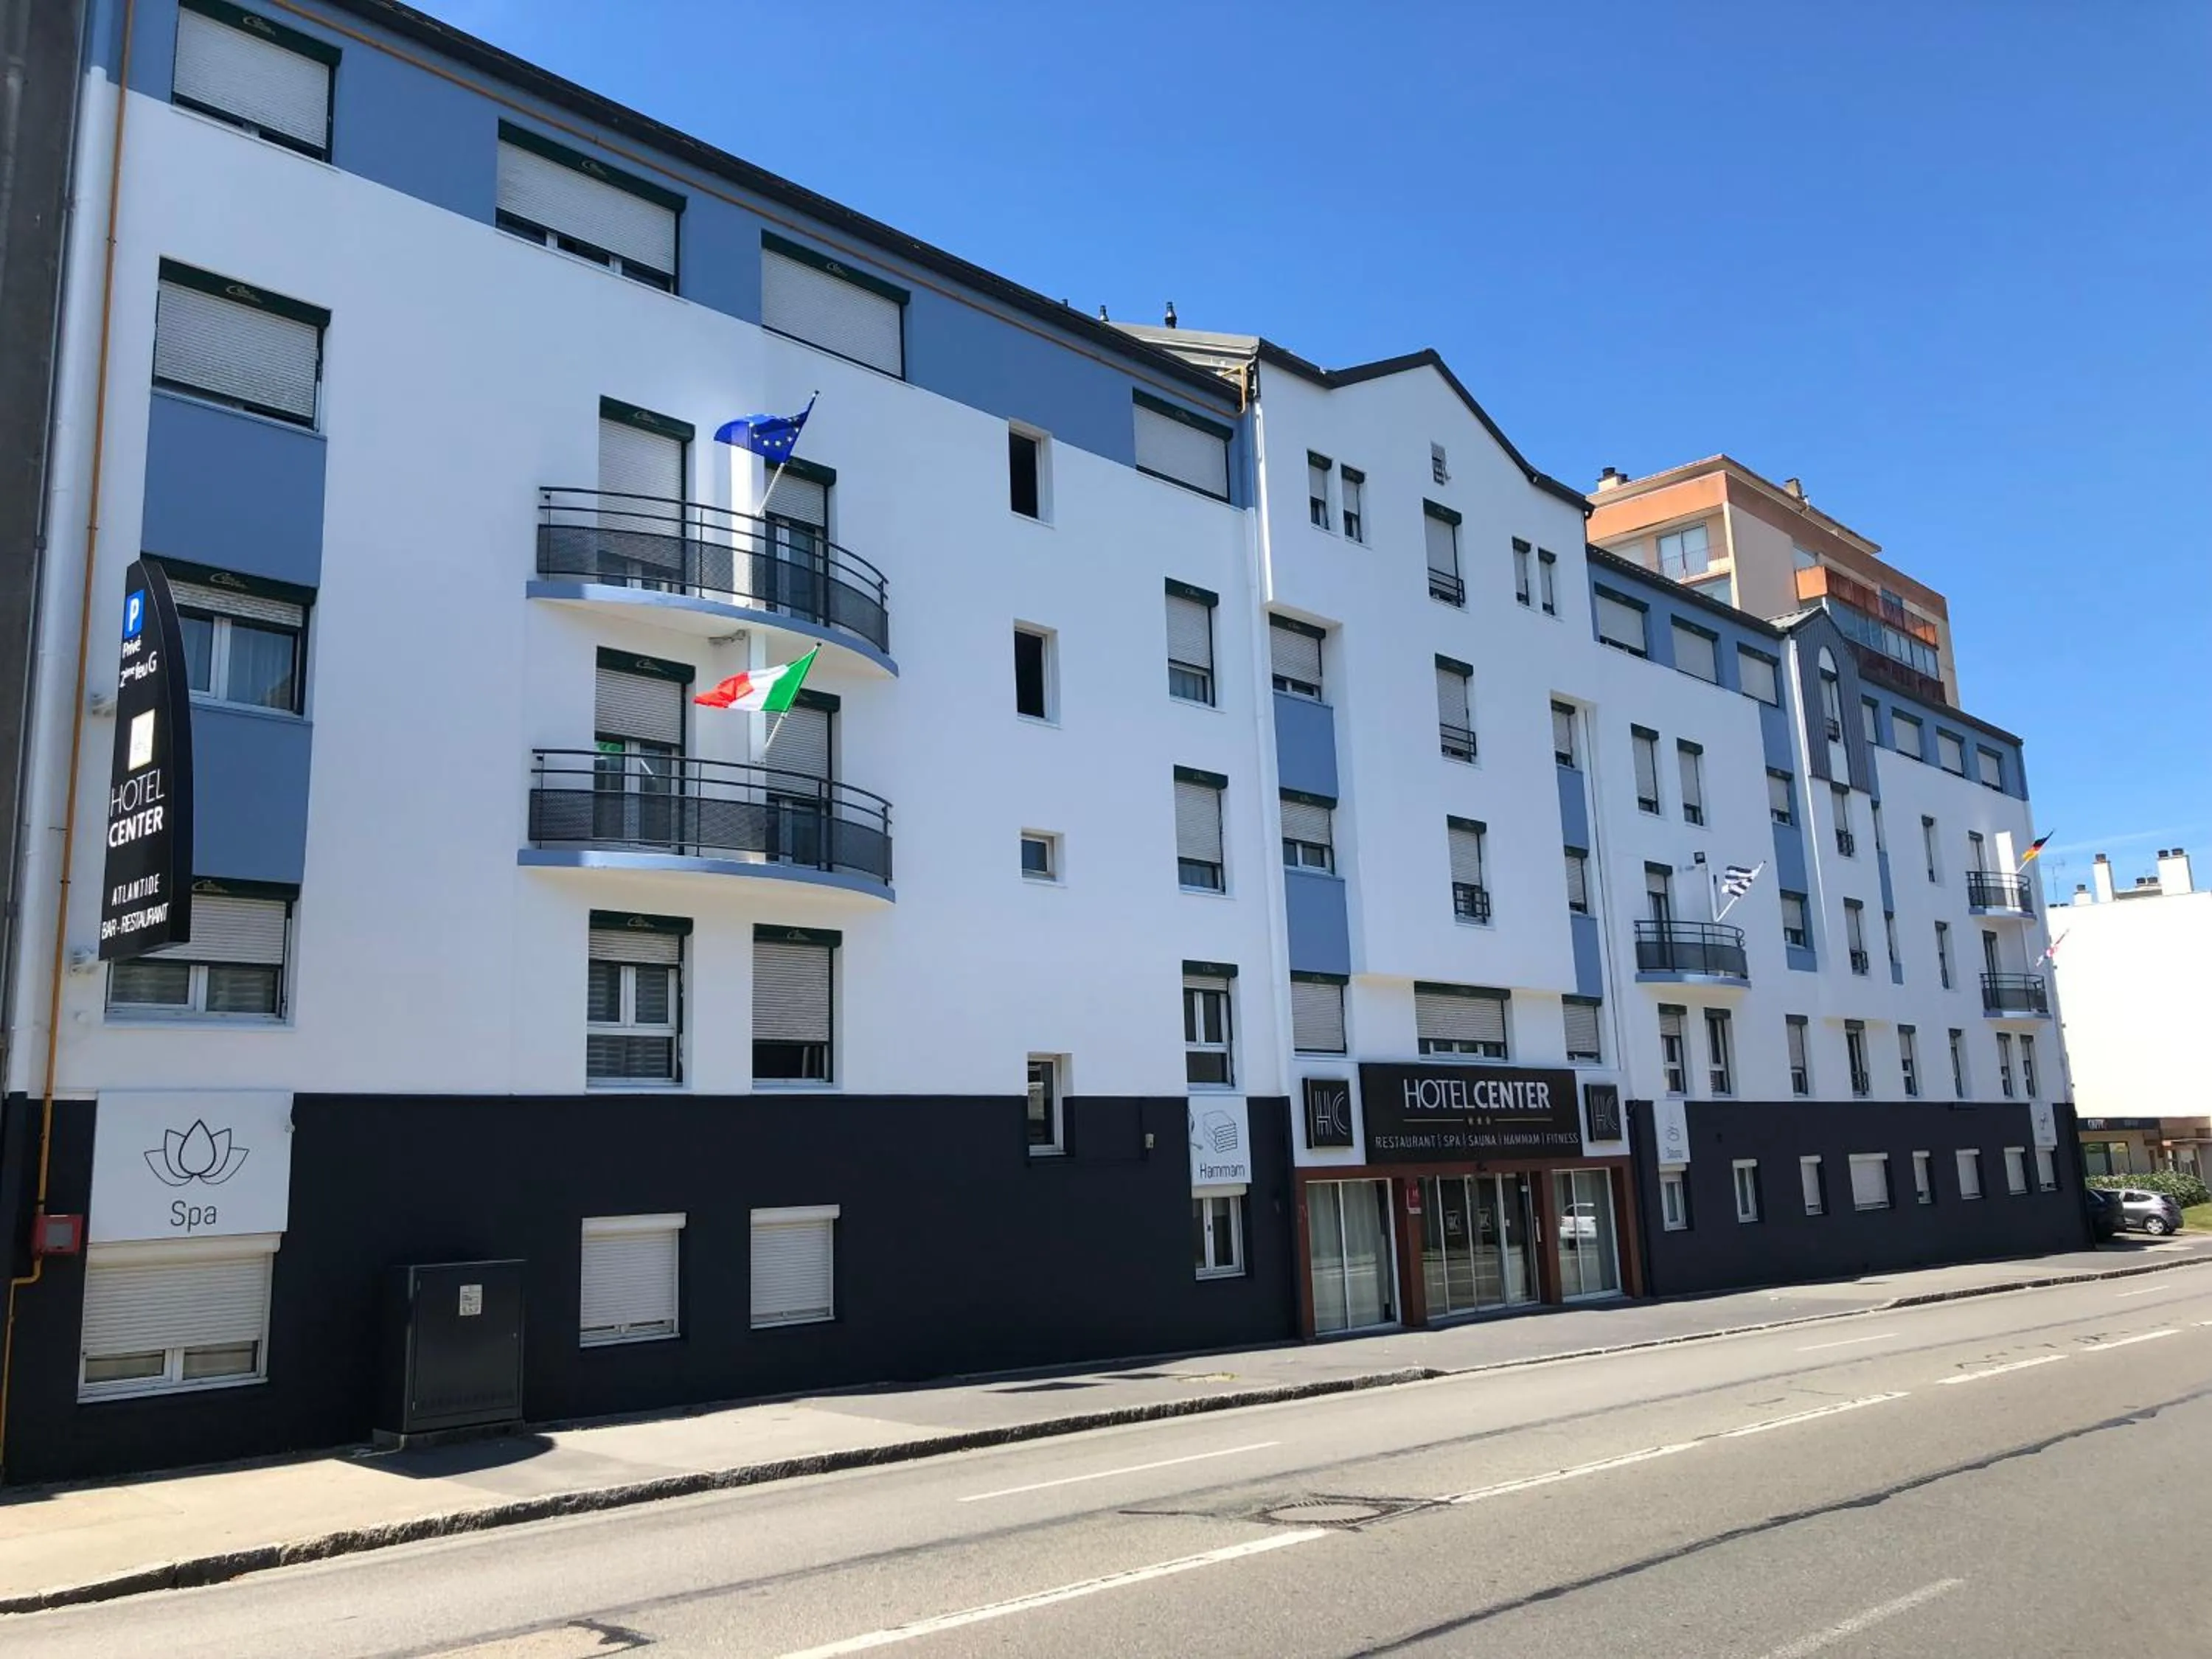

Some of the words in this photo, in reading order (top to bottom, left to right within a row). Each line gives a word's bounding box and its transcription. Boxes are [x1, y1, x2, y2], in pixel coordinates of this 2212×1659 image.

[128, 597, 140, 632] P
[122, 635, 142, 658] Privé
[148, 651, 157, 672] G
[110, 769, 165, 818] HOTEL
[108, 805, 164, 848] CENTER
[111, 873, 160, 906] ATLANTIDE
[101, 918, 117, 940] BAR
[120, 902, 170, 934] RESTAURANT
[1315, 1091, 1349, 1136] HC
[1375, 1135, 1436, 1149] RESTAURANT
[1443, 1135, 1461, 1147] SPA
[1468, 1133, 1497, 1147] SAUNA
[1503, 1133, 1540, 1145] HAMMAM
[1546, 1132, 1579, 1144] FITNESS
[1200, 1164, 1245, 1178] Hammam
[170, 1200, 218, 1232] Spa
